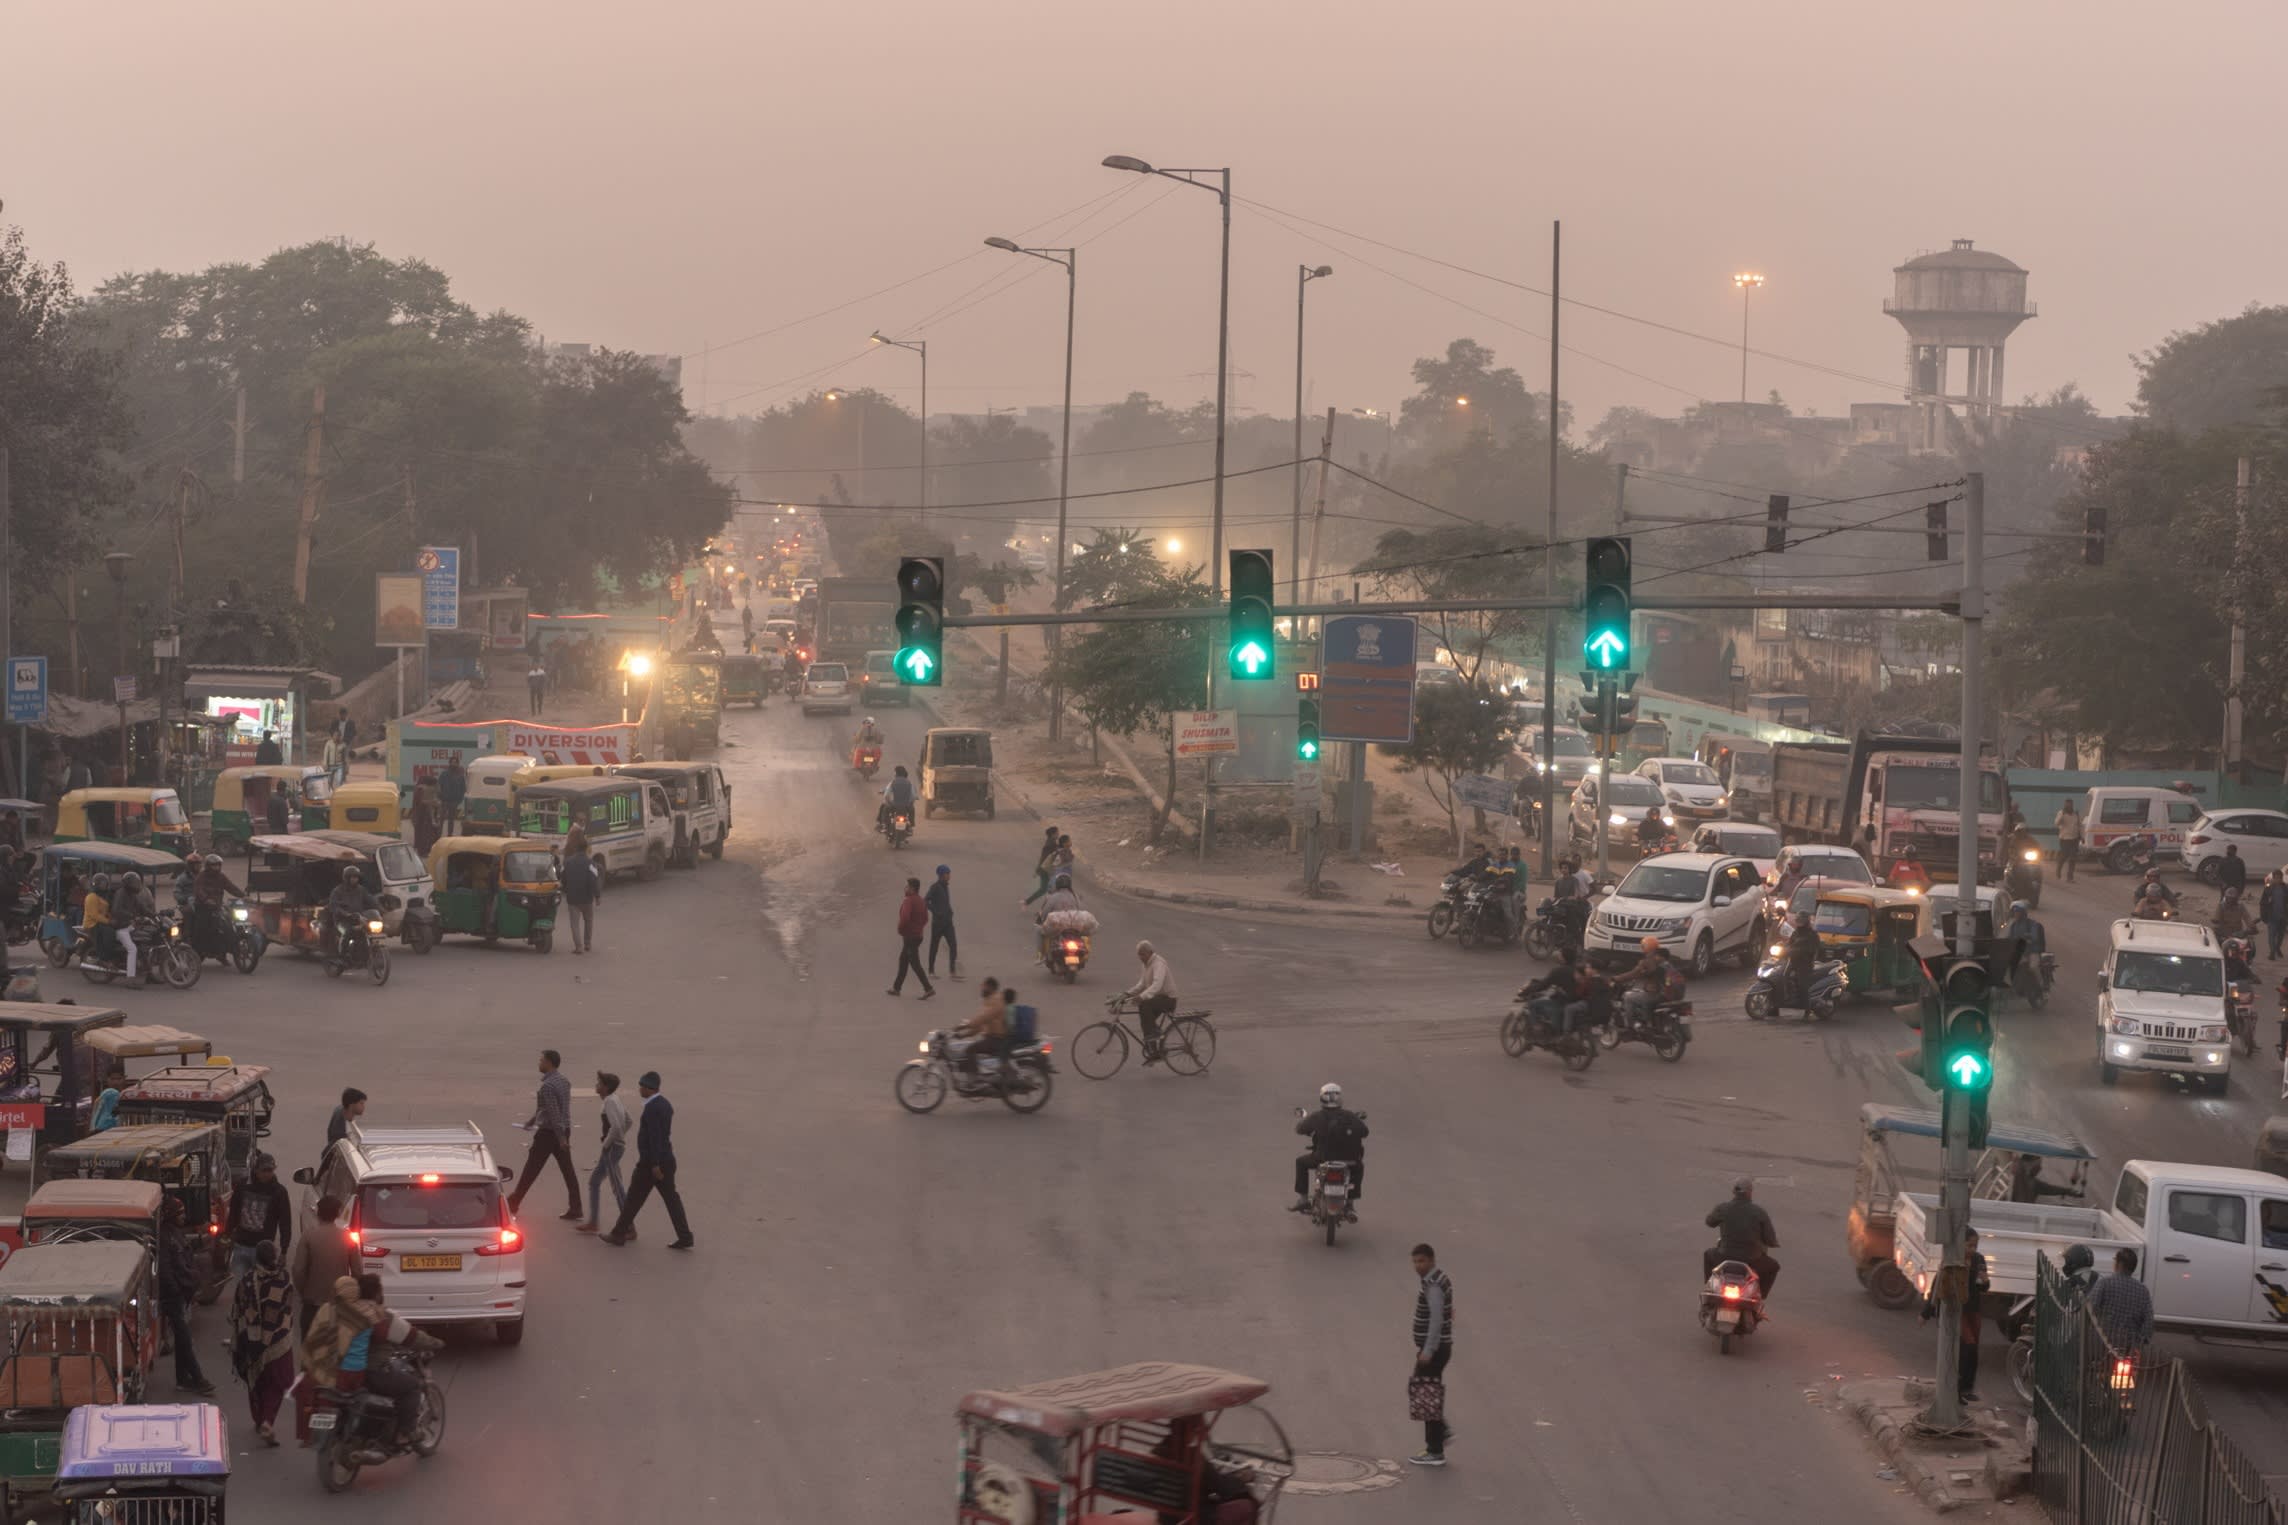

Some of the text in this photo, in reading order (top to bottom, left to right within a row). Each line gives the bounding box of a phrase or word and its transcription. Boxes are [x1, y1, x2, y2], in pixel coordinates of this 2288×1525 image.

[1299, 674, 1318, 689] 07
[1192, 712, 1218, 722] DILIP
[1182, 727, 1231, 738] SHUSMITA
[514, 734, 618, 748] DIVERSION
[2160, 834, 2183, 843] POL
[0, 1111, 25, 1123] irtel
[140, 1461, 172, 1473] RATH
